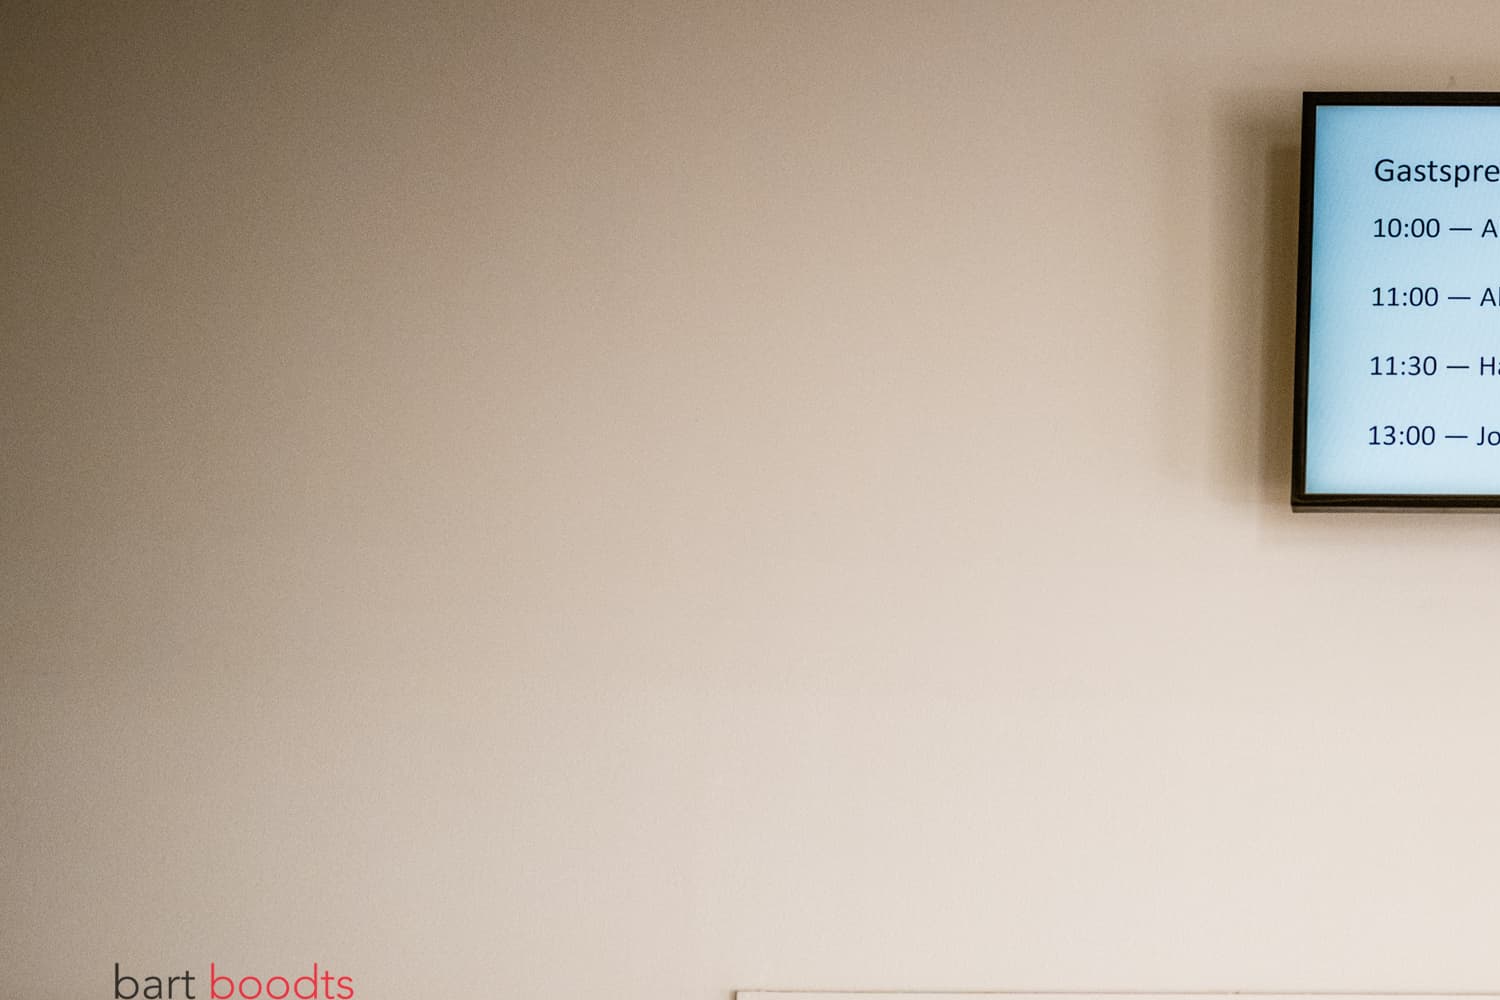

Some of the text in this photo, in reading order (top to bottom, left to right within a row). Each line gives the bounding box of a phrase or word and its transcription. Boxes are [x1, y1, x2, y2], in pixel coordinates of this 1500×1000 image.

[1373, 217, 1441, 239] 10:00
[1371, 286, 1439, 308] 11:00
[1370, 355, 1438, 377] 11:30
[1368, 424, 1436, 446] 13:00
